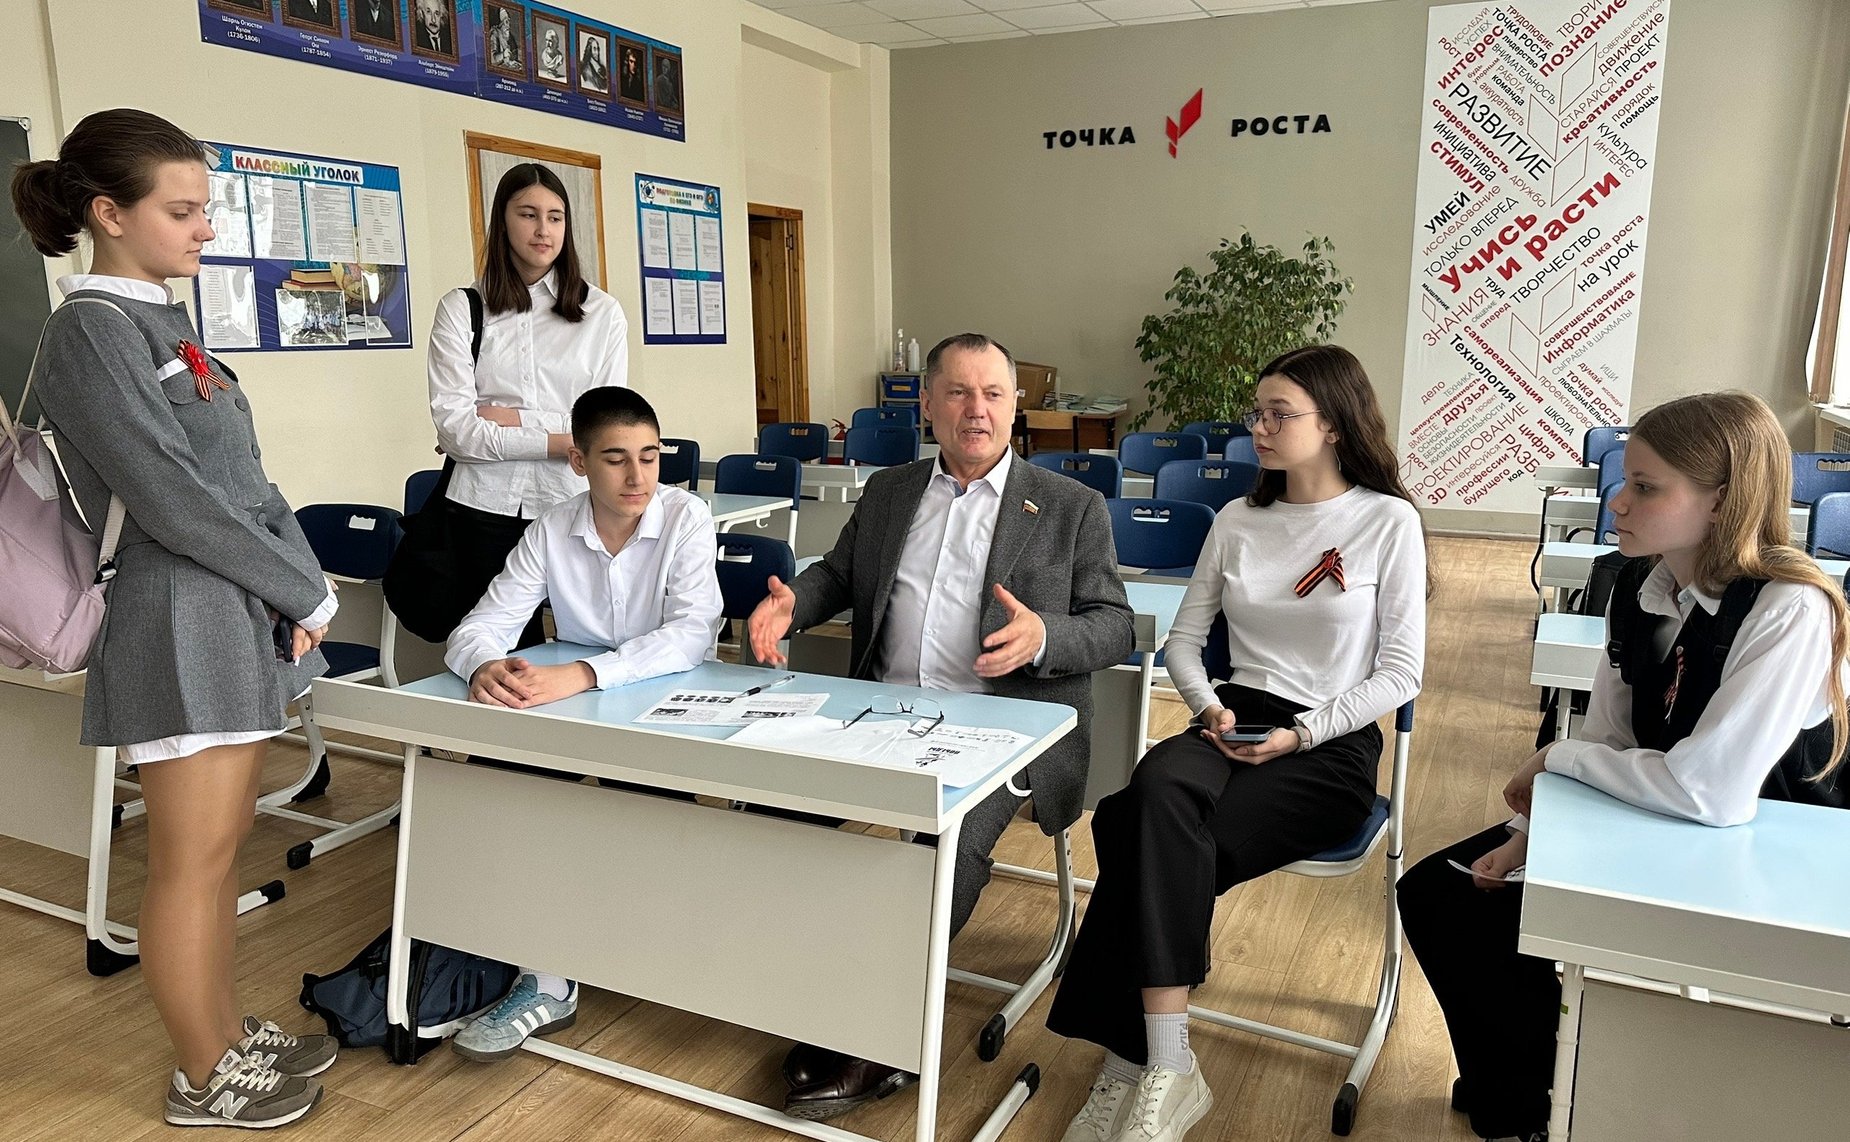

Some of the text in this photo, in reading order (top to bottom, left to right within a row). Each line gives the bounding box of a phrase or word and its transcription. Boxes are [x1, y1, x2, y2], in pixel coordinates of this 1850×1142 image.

[1438, 37, 1461, 58] РОСТ
[1452, 8, 1490, 45] ИССЛЕДУЙ
[1464, 20, 1492, 46] УСПЕХ
[1492, 8, 1548, 62] ТОЧКА РОСТА
[1506, 5, 1554, 50] ТРУДОЛЮБИЕ
[1539, 0, 1627, 77] познание
[1598, 13, 1664, 76] движение
[1438, 26, 1504, 89] интерес
[1472, 58, 1500, 84] упорным
[1502, 36, 1538, 68] лидерство
[1614, 34, 1660, 77] ПРОЕКТ
[1492, 43, 1555, 105] ВНИМАТЕЛЬНОСТЬ
[1492, 74, 1525, 106] команда
[1496, 65, 1526, 94] РАБОТА
[1480, 82, 1524, 126] аккуратность
[1561, 76, 1618, 128] СТАРАЙСЯ
[1562, 61, 1657, 144] креативность
[1611, 82, 1655, 122] порядок
[1619, 95, 1659, 129] помощь
[1043, 114, 1331, 149] ТОЧКА РОСТА
[1432, 99, 1509, 174] современность
[1433, 120, 1496, 182] инициатива
[1448, 82, 1552, 181] РАЗВИТИЕ
[1597, 122, 1648, 170] культура
[235, 156, 361, 182] КЛАССНЫЙ УГОЛОК
[1431, 142, 1485, 194] СТИМУЛ
[1593, 139, 1634, 178] ИНТЕРЕС
[1424, 191, 1471, 234] УМЕЙ
[1509, 175, 1546, 208] дружба
[1423, 186, 1501, 256] исследование
[1424, 196, 1519, 277] ТОЛЬКО ВПЕРЕД
[1496, 172, 1621, 281] и расти
[1580, 215, 1644, 269] точка роста
[1438, 214, 1537, 294] Учись
[1509, 227, 1600, 304] ТВОРЧЕСТВО
[1577, 240, 1639, 292] на урок
[1485, 276, 1505, 299] труд
[1422, 288, 1489, 346] ЗНАНИЯ
[1480, 302, 1511, 329] вперед
[1543, 290, 1635, 364] Информатика
[1544, 271, 1636, 348] СОВЕРШЕНСТВОВАНИЕ
[1552, 345, 1589, 376] СЫГРАЕМ
[1593, 309, 1633, 340] ШАХМАТЫ
[1444, 372, 1475, 398] ТЕХНИКА
[1450, 333, 1516, 402] Технология
[1464, 325, 1544, 404] самореализация
[1578, 362, 1602, 385] думай
[1600, 364, 1619, 382] ИЩИ
[1410, 378, 1481, 436] целеустремленность
[1421, 381, 1446, 405] дело
[1442, 383, 1489, 426] друзья
[1475, 394, 1498, 414] проект
[1567, 370, 1622, 425] точка роста
[1601, 386, 1624, 408] исследуй
[1408, 423, 1439, 449] ВМЕСТЕ
[1418, 428, 1448, 453] ОСНОВЫ
[1423, 414, 1477, 460] БЕЗОПАСНОСТИ
[1518, 424, 1555, 460] цифра
[1544, 406, 1574, 436] ШКОЛА
[1407, 453, 1428, 471] рост
[1408, 402, 1528, 496] ПРОЕКТИРОВАНИЕ
[1446, 444, 1501, 489] интересуйся
[1428, 488, 1447, 504] 3D
[1456, 453, 1510, 496] профессии
[1464, 468, 1510, 505] будущего
[1508, 469, 1525, 482] код
[209, 1090, 249, 1120] N
